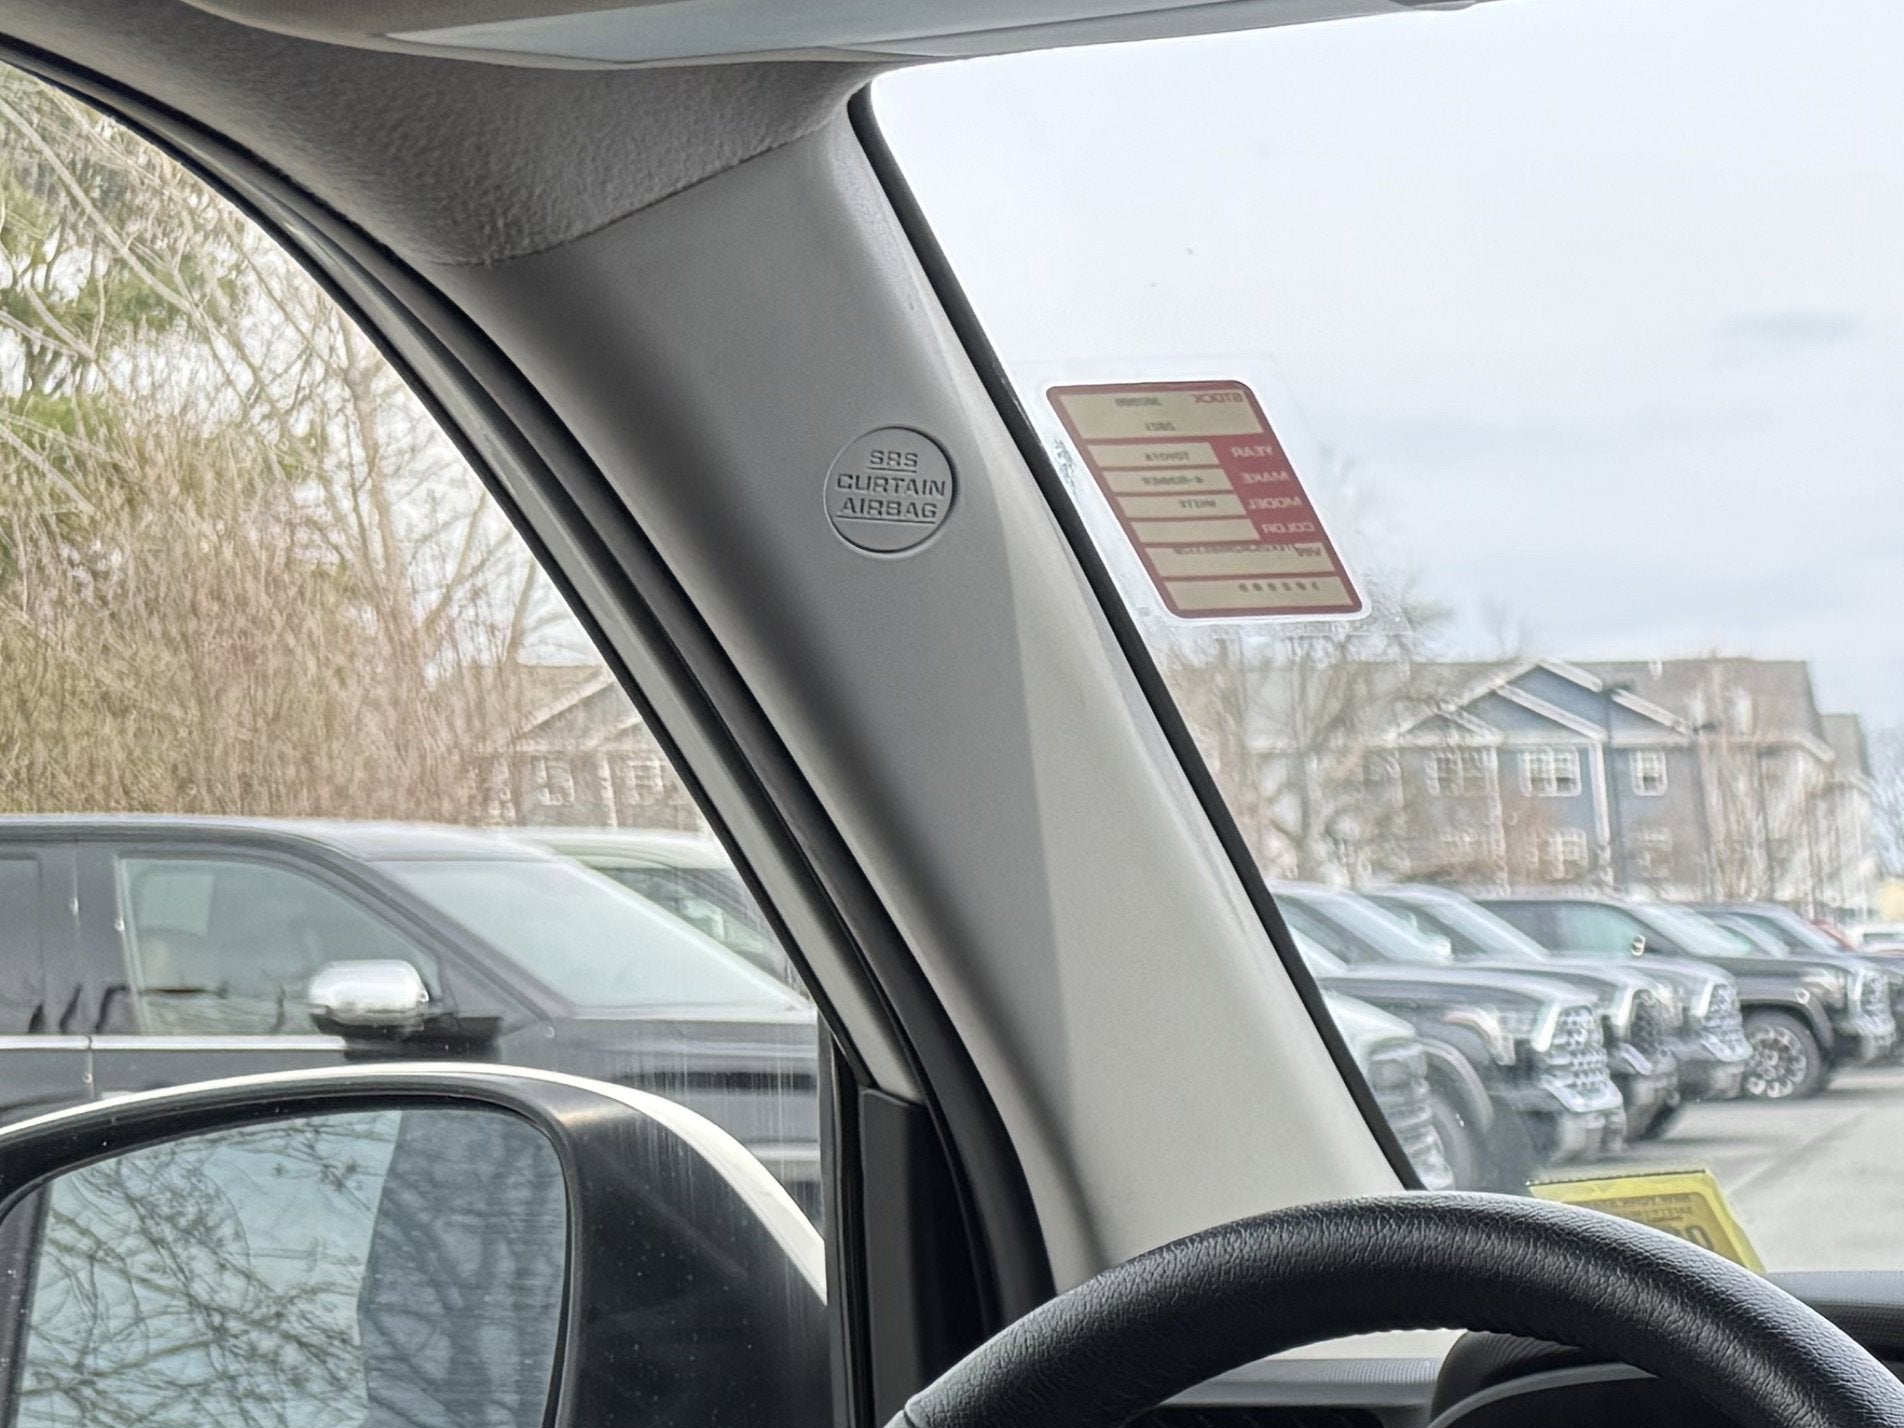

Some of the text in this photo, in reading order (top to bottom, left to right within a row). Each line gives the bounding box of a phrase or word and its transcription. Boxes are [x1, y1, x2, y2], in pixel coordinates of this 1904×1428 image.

[869, 449, 919, 468] SRS
[837, 473, 946, 497] CURTAIN
[842, 497, 938, 519] AIRBAG
